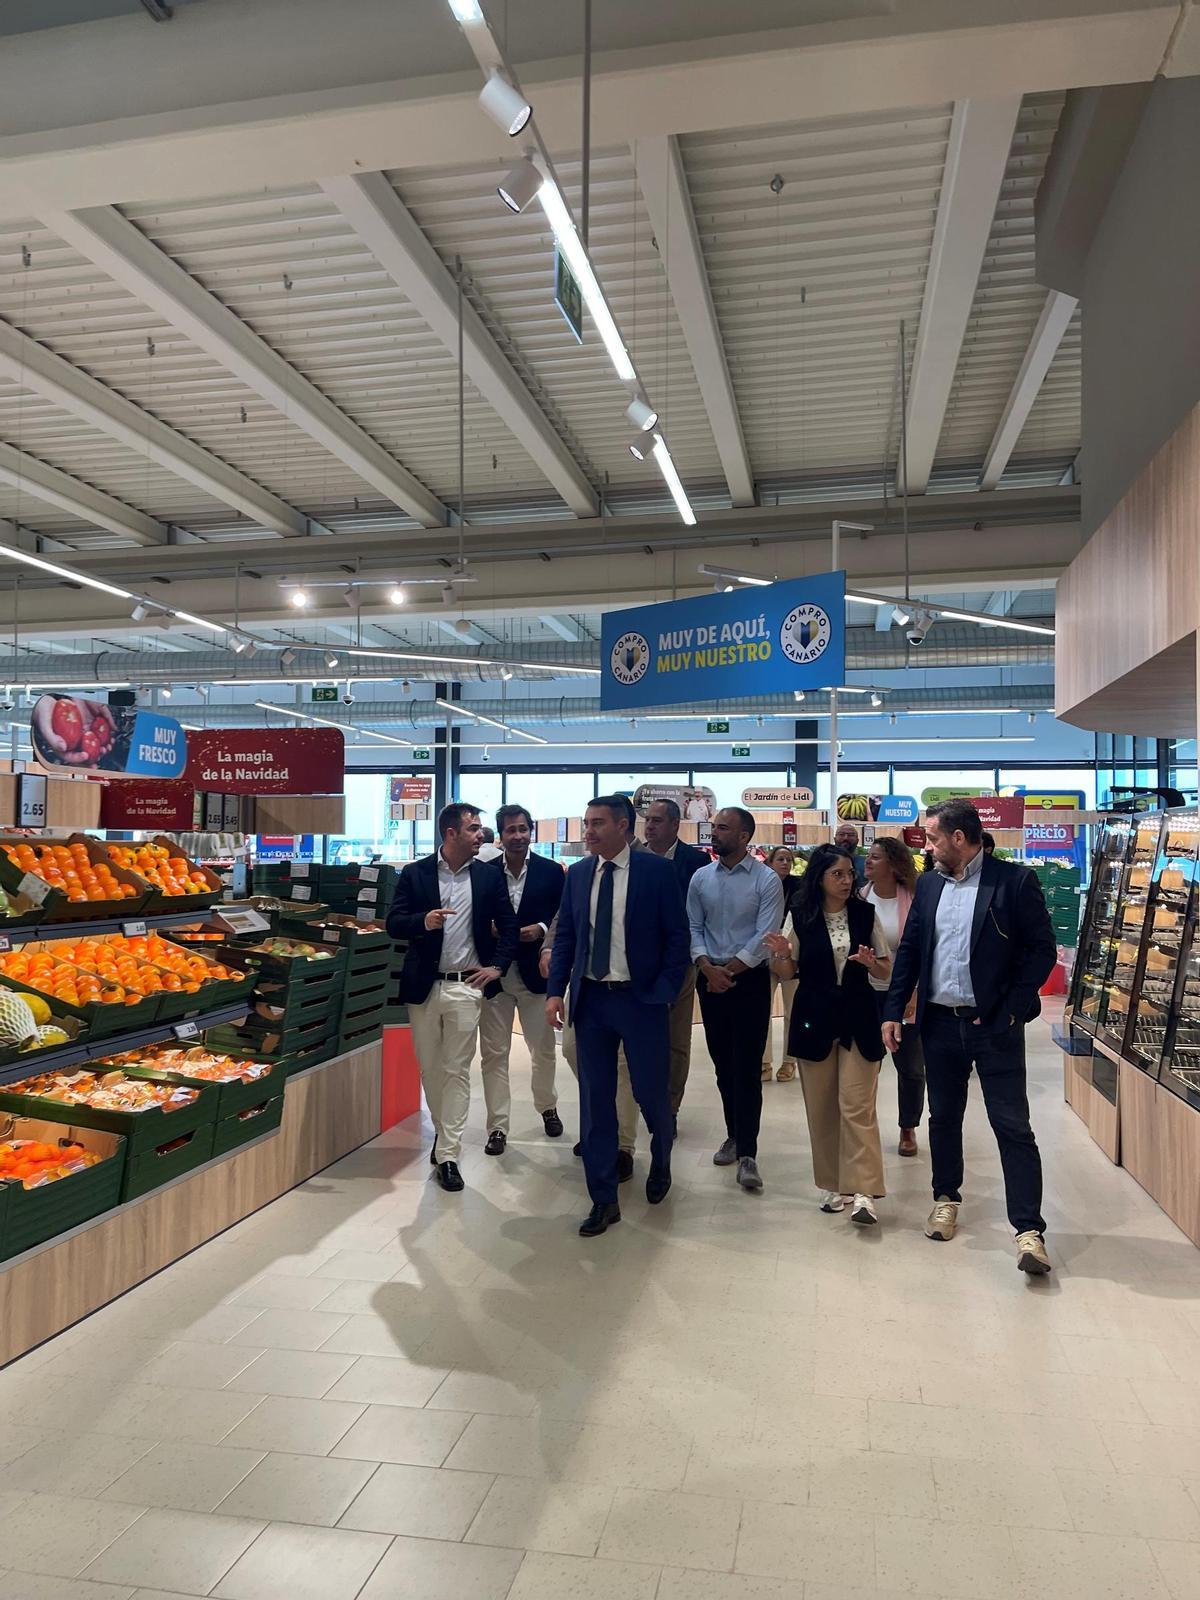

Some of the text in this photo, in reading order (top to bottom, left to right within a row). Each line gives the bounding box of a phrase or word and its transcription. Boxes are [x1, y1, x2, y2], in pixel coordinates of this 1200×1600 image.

[785, 607, 827, 631] COMPRO
[659, 613, 771, 651] MUY DE AQUÍ,
[614, 635, 647, 656] COMPRO
[785, 638, 826, 661] CANARIO
[657, 641, 772, 673] MUY NUESTRO
[614, 663, 646, 682] CANARIO
[154, 727, 177, 745] MUY
[139, 744, 176, 765] FRESCO
[217, 750, 274, 765] La magia
[202, 767, 289, 780] de la Navidad
[145, 797, 169, 806] magia
[744, 792, 810, 801] El Jardín de Lidl
[23, 803, 44, 816] 2.65
[146, 807, 177, 815] Navidad
[898, 800, 912, 808] MUY
[978, 807, 995, 815] magia
[885, 808, 912, 817] NUESTRO
[1025, 828, 1067, 839] PRECIO
